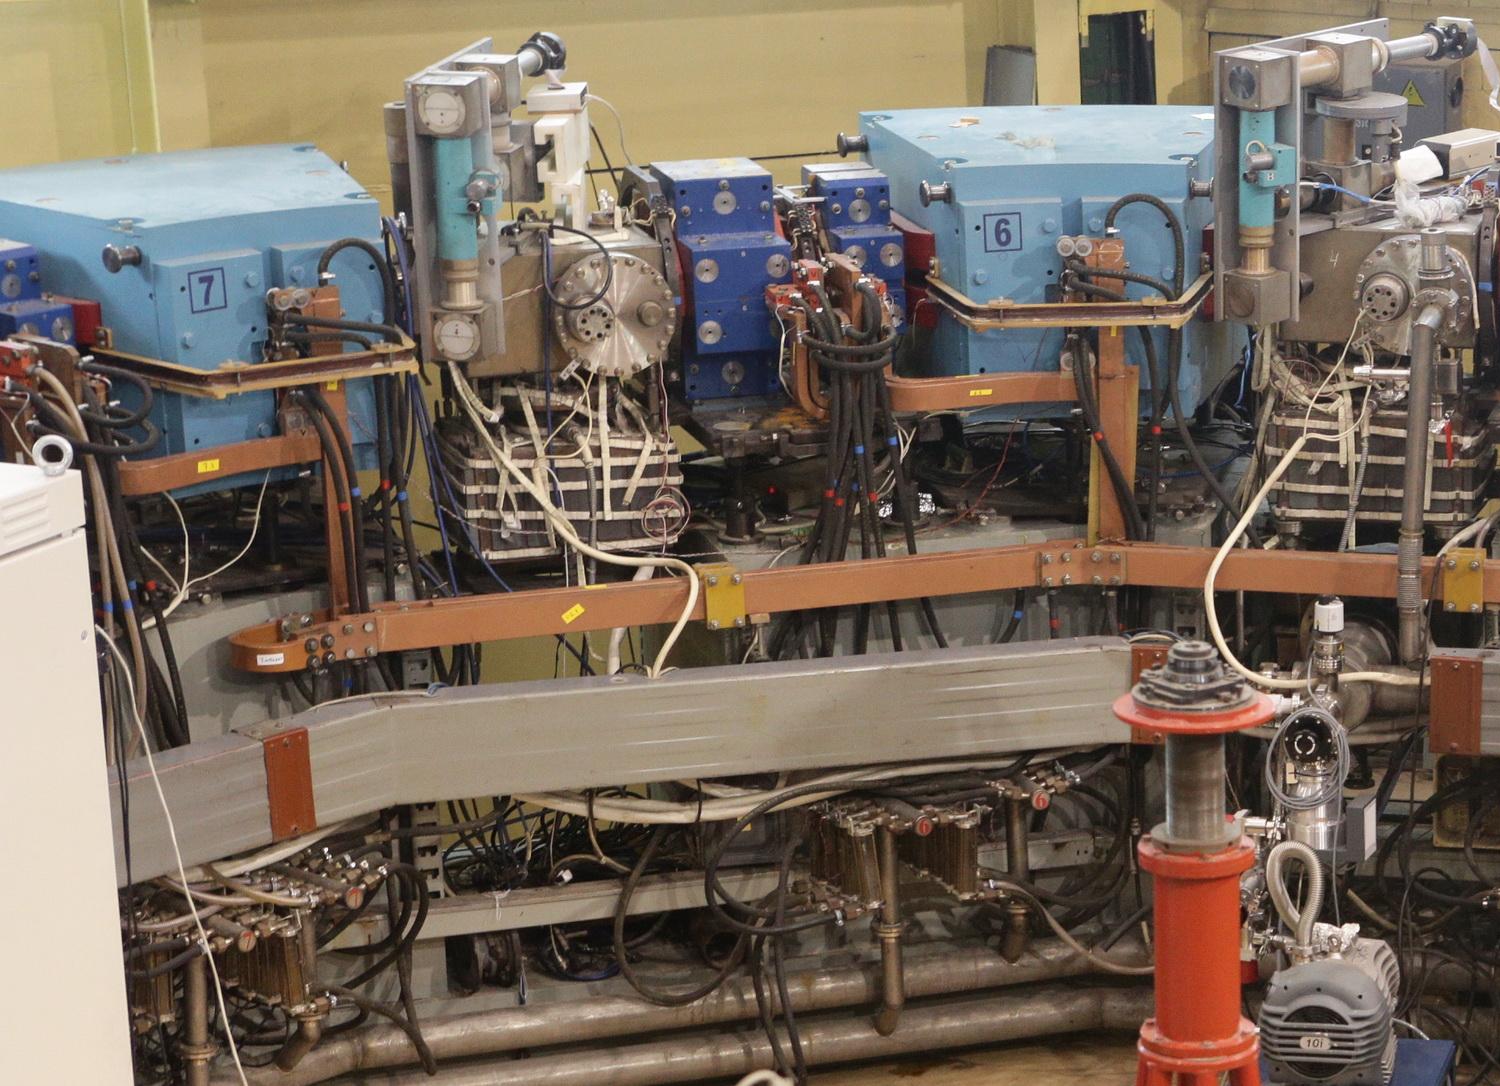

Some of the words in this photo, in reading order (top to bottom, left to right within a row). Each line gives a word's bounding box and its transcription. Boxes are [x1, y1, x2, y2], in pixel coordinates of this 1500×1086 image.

[994, 217, 1012, 247] 6
[1329, 249, 1340, 271] 4
[198, 274, 214, 306] 7
[1034, 791, 1048, 808] 6
[1306, 1038, 1324, 1049] 10i
